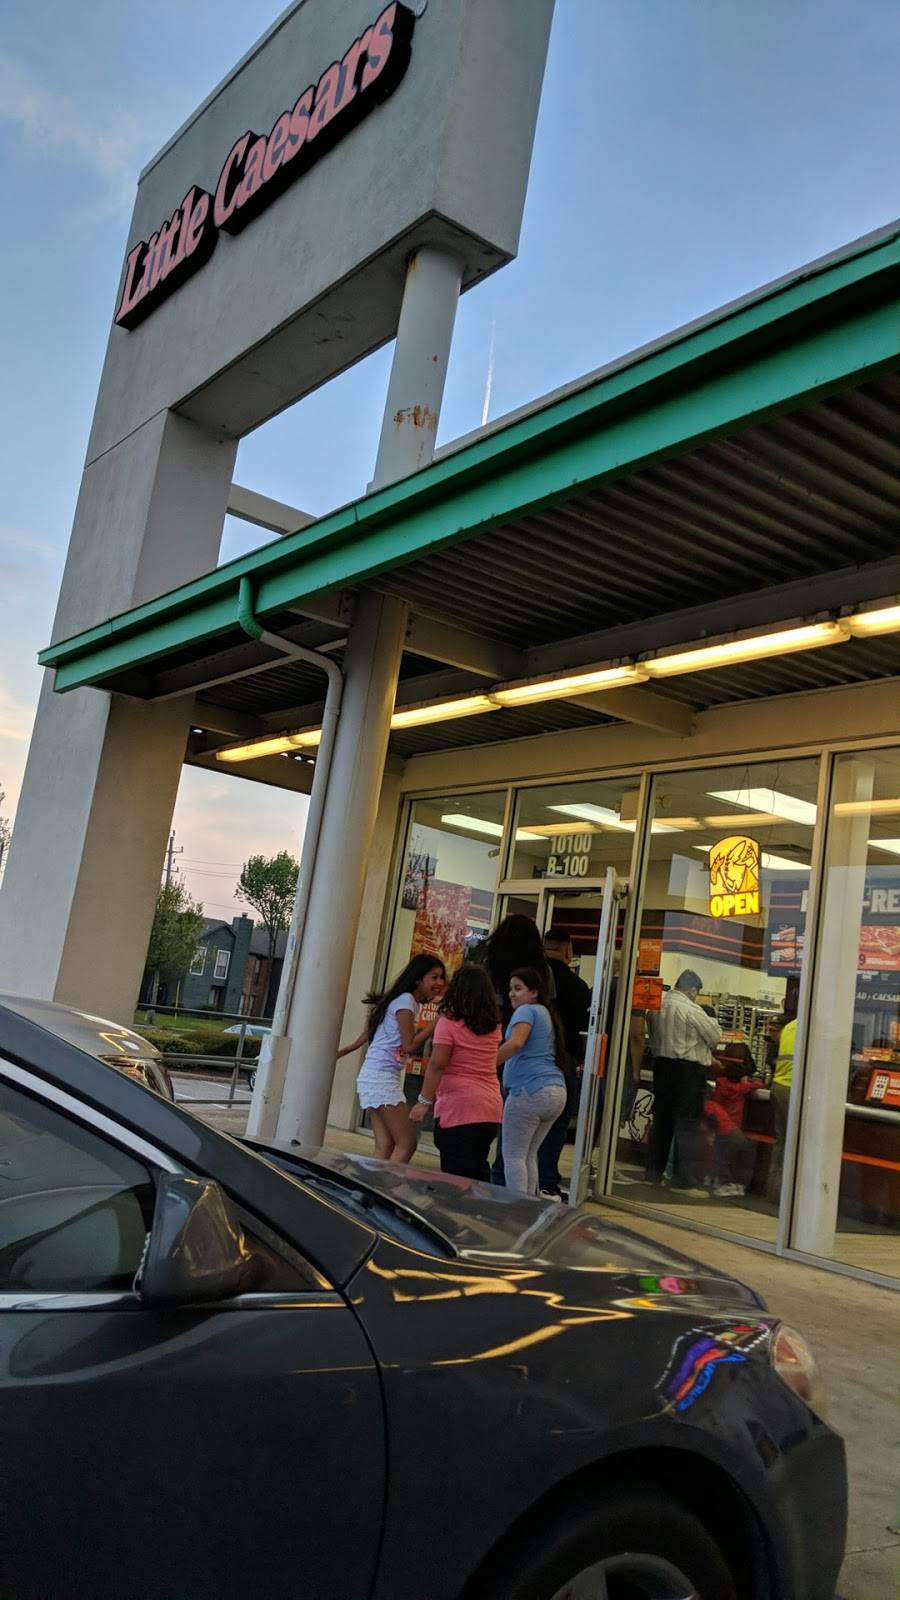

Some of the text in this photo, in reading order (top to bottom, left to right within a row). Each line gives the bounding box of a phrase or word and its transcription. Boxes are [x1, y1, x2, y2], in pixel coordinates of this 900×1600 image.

[115, 1, 398, 323] Little Caesars
[551, 835, 592, 854] 10100
[546, 856, 588, 876] B-100
[711, 891, 760, 918] OPEN
